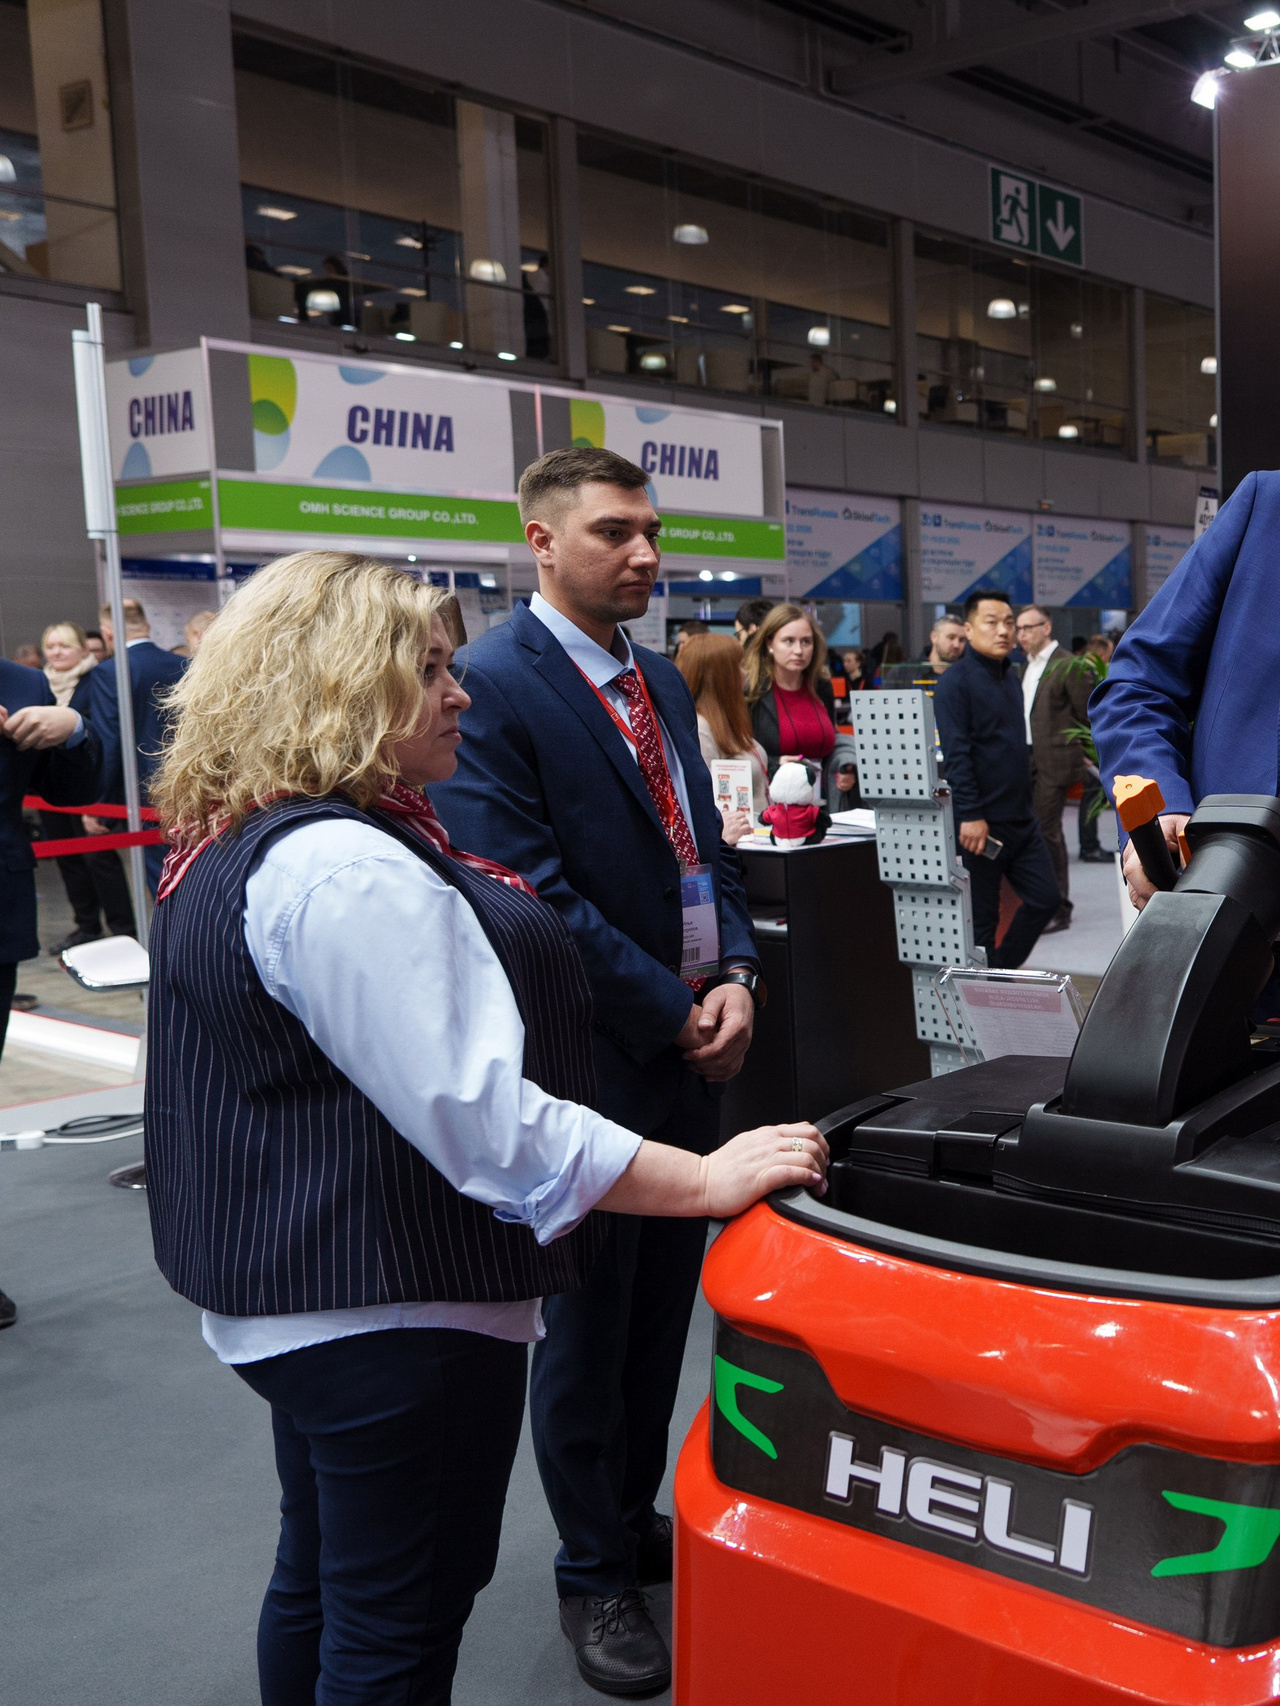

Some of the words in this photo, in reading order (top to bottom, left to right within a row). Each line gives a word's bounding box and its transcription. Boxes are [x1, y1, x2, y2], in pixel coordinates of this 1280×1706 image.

[129, 390, 196, 439] CHINA
[346, 404, 456, 454] CHINA
[640, 440, 721, 482] CHINA
[300, 500, 330, 515] OMH
[333, 503, 386, 519] SCIENCE
[388, 506, 432, 523] GROUP
[825, 1434, 1094, 1576] HELI
